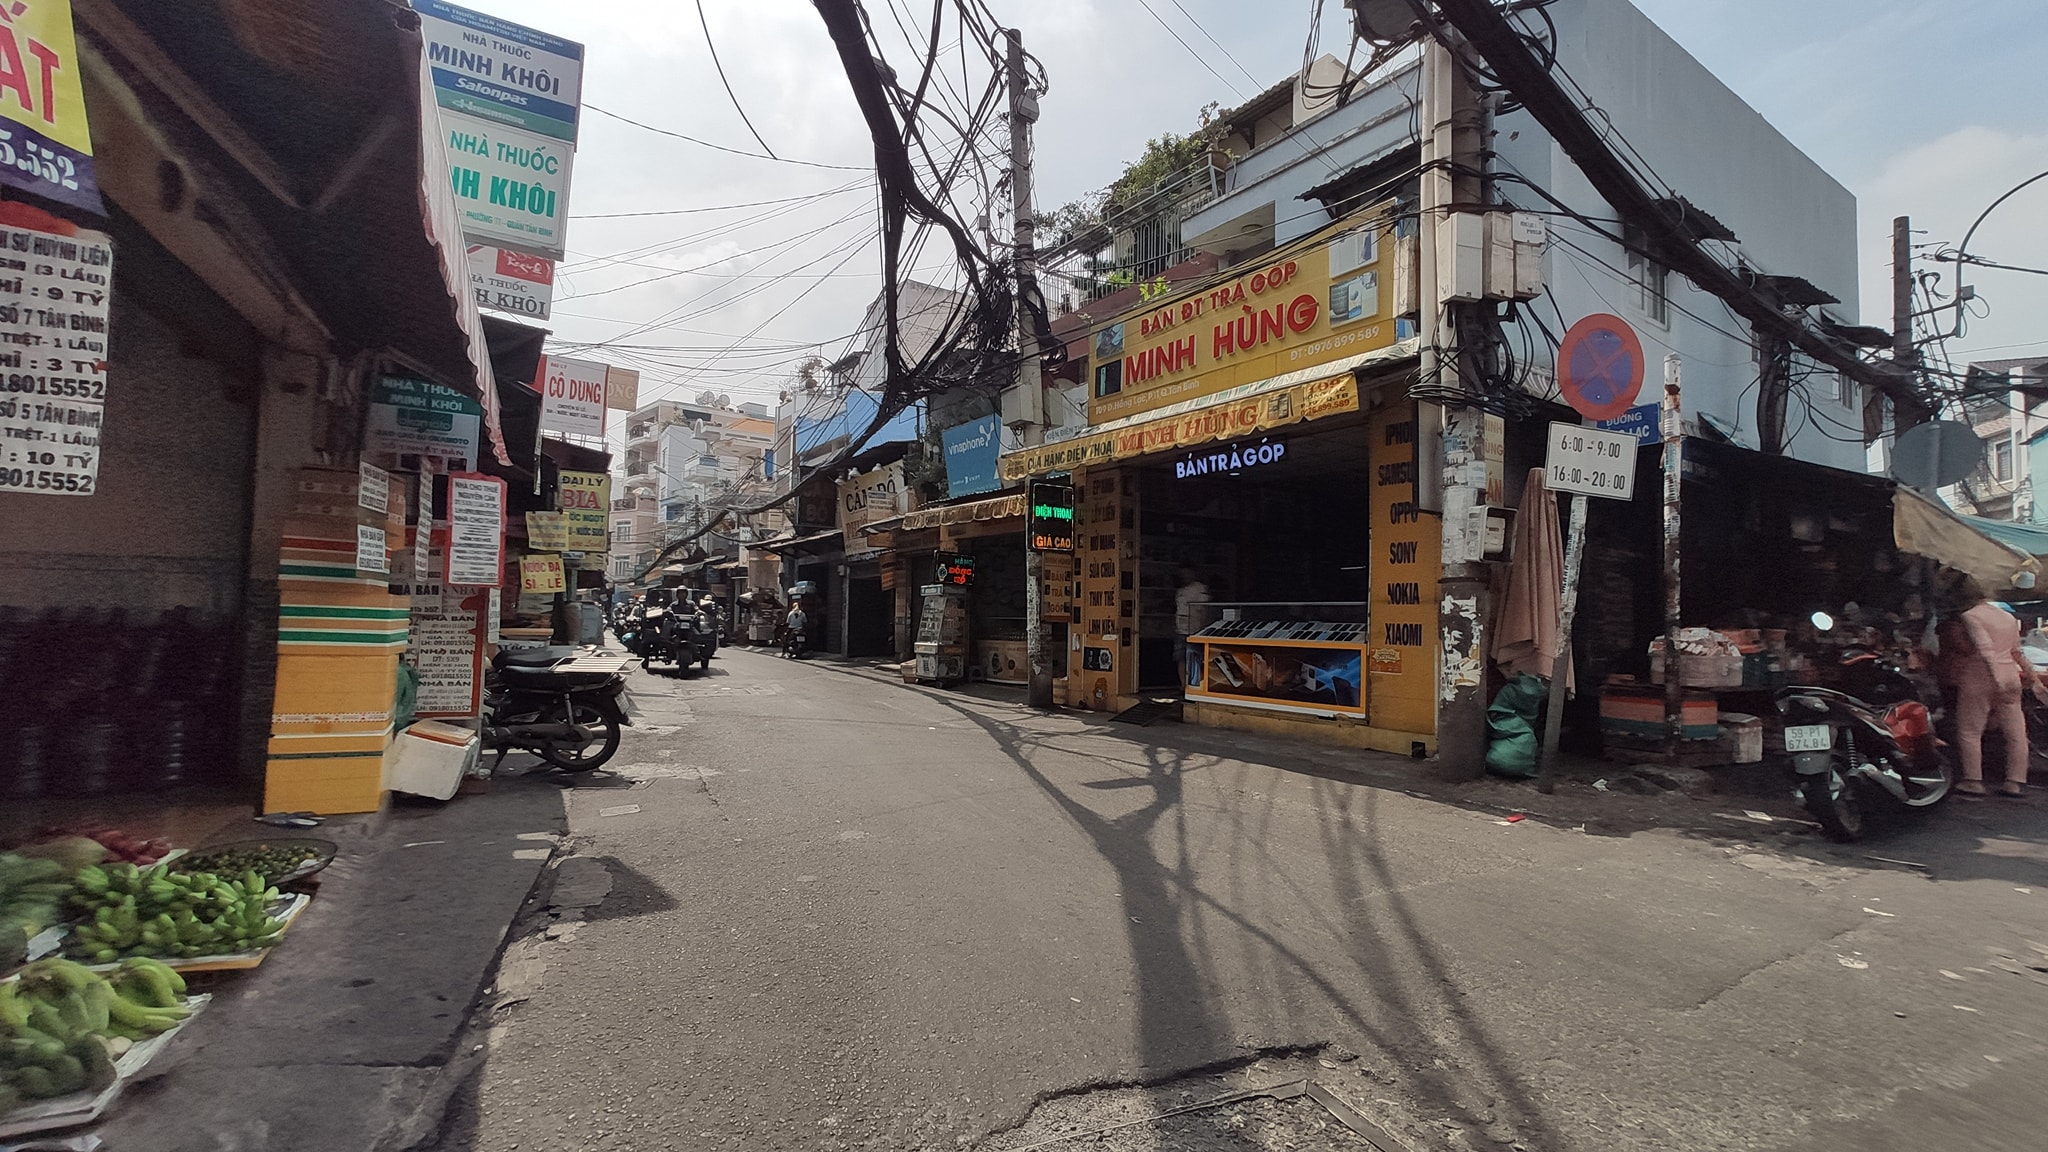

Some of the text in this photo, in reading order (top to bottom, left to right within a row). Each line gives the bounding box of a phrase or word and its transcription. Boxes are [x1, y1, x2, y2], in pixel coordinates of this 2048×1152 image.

[462, 31, 532, 60] NHÀ THUỐC
[429, 41, 559, 95] MINH KHÔI
[455, 77, 528, 106] Salonpas
[450, 130, 558, 175] NHÀ THUỐC
[490, 176, 556, 218] KHÔI
[488, 278, 528, 292] THUỐC
[47, 287, 63, 300] 9
[72, 290, 104, 306] TỶ
[497, 293, 546, 315] KHÔI
[23, 308, 32, 325] 7
[37, 308, 66, 329] TÂN
[71, 311, 105, 333] BÌNH
[1140, 309, 1175, 337] BÁN
[1181, 298, 1205, 321] ĐT
[1125, 294, 1319, 387] MINH HÙNG
[1334, 333, 1355, 347] 899
[1358, 326, 1379, 340] 589
[47, 358, 62, 371] 3
[421, 383, 468, 398] THU
[549, 371, 601, 405] CÔ DUNG
[1183, 380, 1200, 390] Bình
[21, 403, 31, 420] 5
[35, 402, 63, 423] TÂN
[431, 399, 462, 411] KHÔI
[1119, 425, 1176, 452] MINH
[1185, 405, 1259, 439] HÙNG
[948, 436, 985, 456] vinaphone
[1561, 435, 1583, 453] 6:00
[1597, 440, 1621, 458] 9:00
[27, 451, 93, 468] 10 TỶ
[1176, 437, 1285, 479] BÁN TRẢ GÓP
[455, 481, 468, 489] NHÀ
[587, 475, 604, 487] LÝ
[1553, 465, 1582, 484] 16:00
[1591, 471, 1625, 490] 20:00
[562, 489, 601, 509] BIA
[1035, 504, 1072, 522] ĐIỆN THOẠI
[1390, 501, 1418, 525] OPPO
[1036, 534, 1071, 548] GIÁ CAO
[1390, 541, 1418, 565] SONY
[1089, 591, 1103, 606] THAY
[1388, 582, 1420, 605] NOKIA
[1385, 623, 1422, 646] XIAOMI
